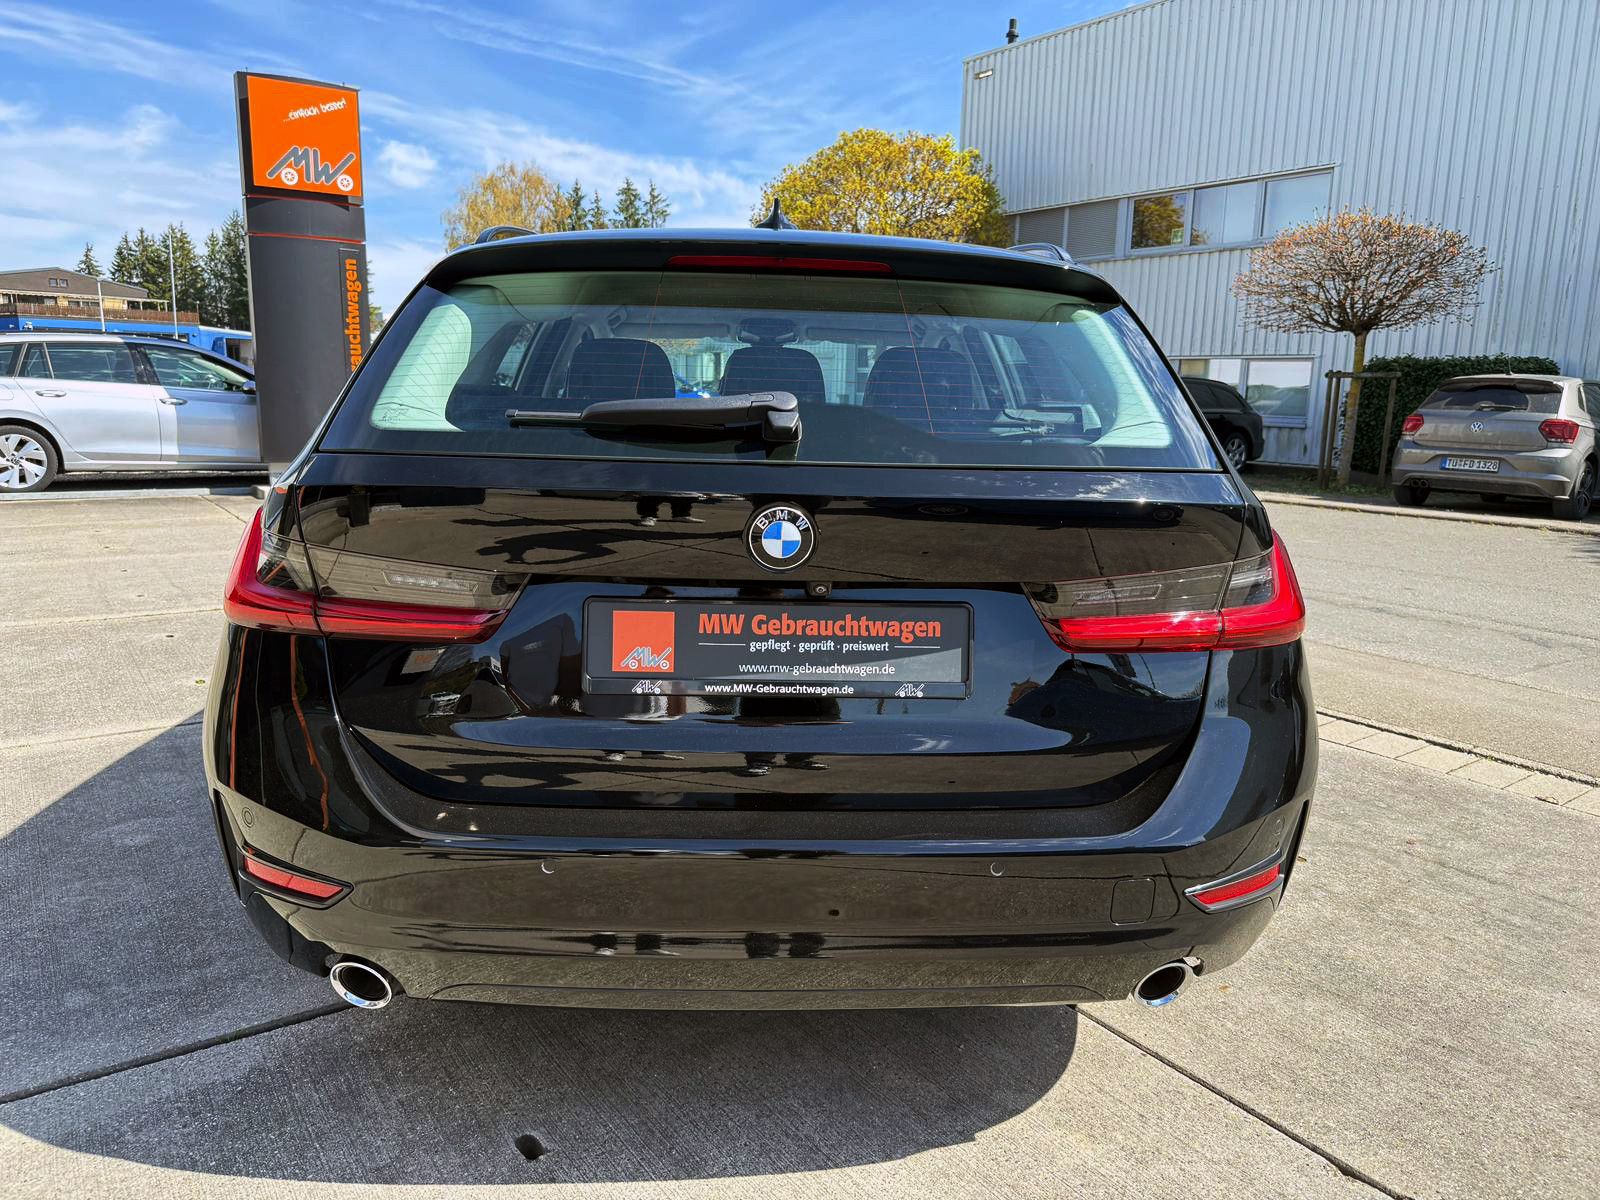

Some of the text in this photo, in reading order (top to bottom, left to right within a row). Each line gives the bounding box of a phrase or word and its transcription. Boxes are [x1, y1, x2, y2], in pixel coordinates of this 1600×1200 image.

[267, 145, 356, 187] MW
[756, 509, 809, 531] BMW
[698, 613, 942, 643] MW Gebrauchtwagen
[750, 638, 890, 653] gepflegt geprüft preiswert
[621, 647, 672, 670] MW
[739, 662, 896, 676] www.mw-gebrauchtwagen.de
[705, 684, 855, 697] www.MW-Gebrauchtwagen.de
